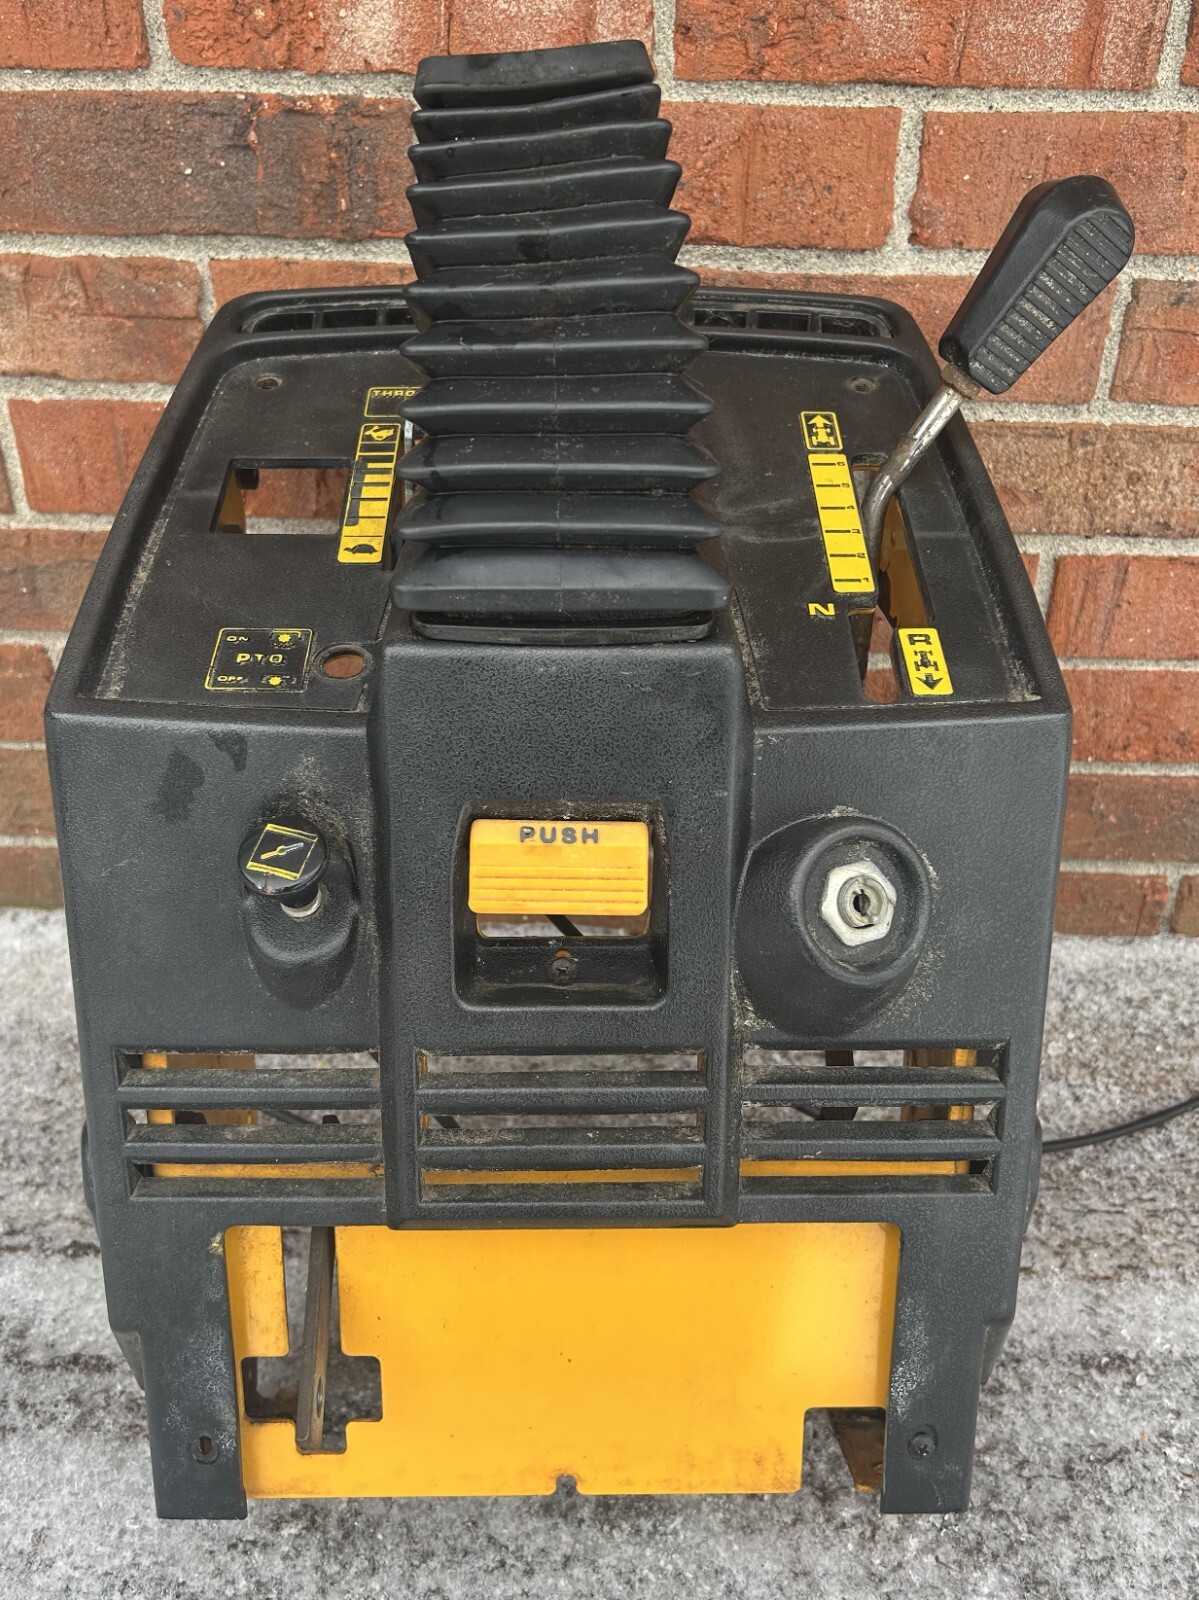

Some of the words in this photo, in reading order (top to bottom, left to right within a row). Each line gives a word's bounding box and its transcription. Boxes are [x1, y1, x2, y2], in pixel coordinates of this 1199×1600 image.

[808, 603, 835, 616] N
[907, 633, 932, 645] R
[236, 653, 283, 663] PTO
[519, 825, 599, 844] PUSH
